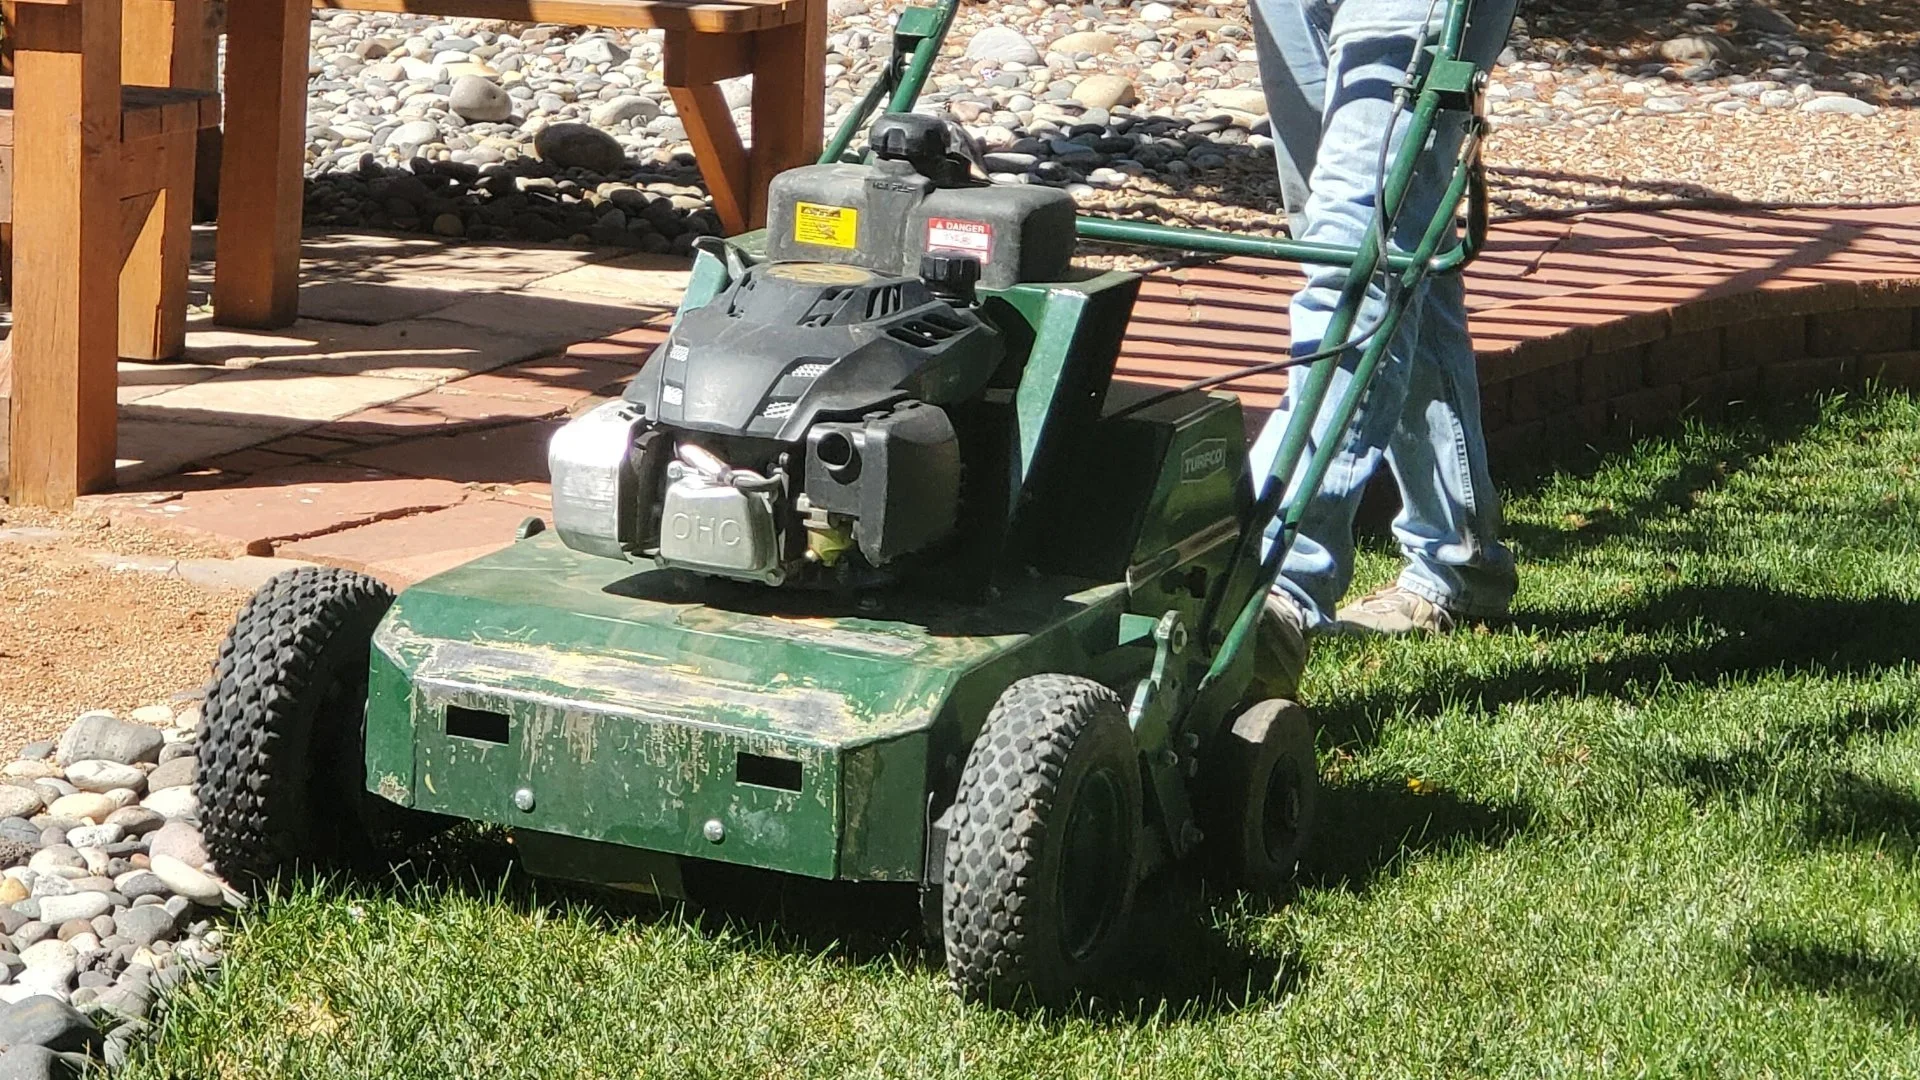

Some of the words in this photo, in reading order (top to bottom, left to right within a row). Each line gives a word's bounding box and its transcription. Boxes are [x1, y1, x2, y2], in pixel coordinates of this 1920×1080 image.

[946, 222, 985, 234] DANGER
[1185, 448, 1222, 474] TURFCO
[673, 512, 741, 545] OHC
